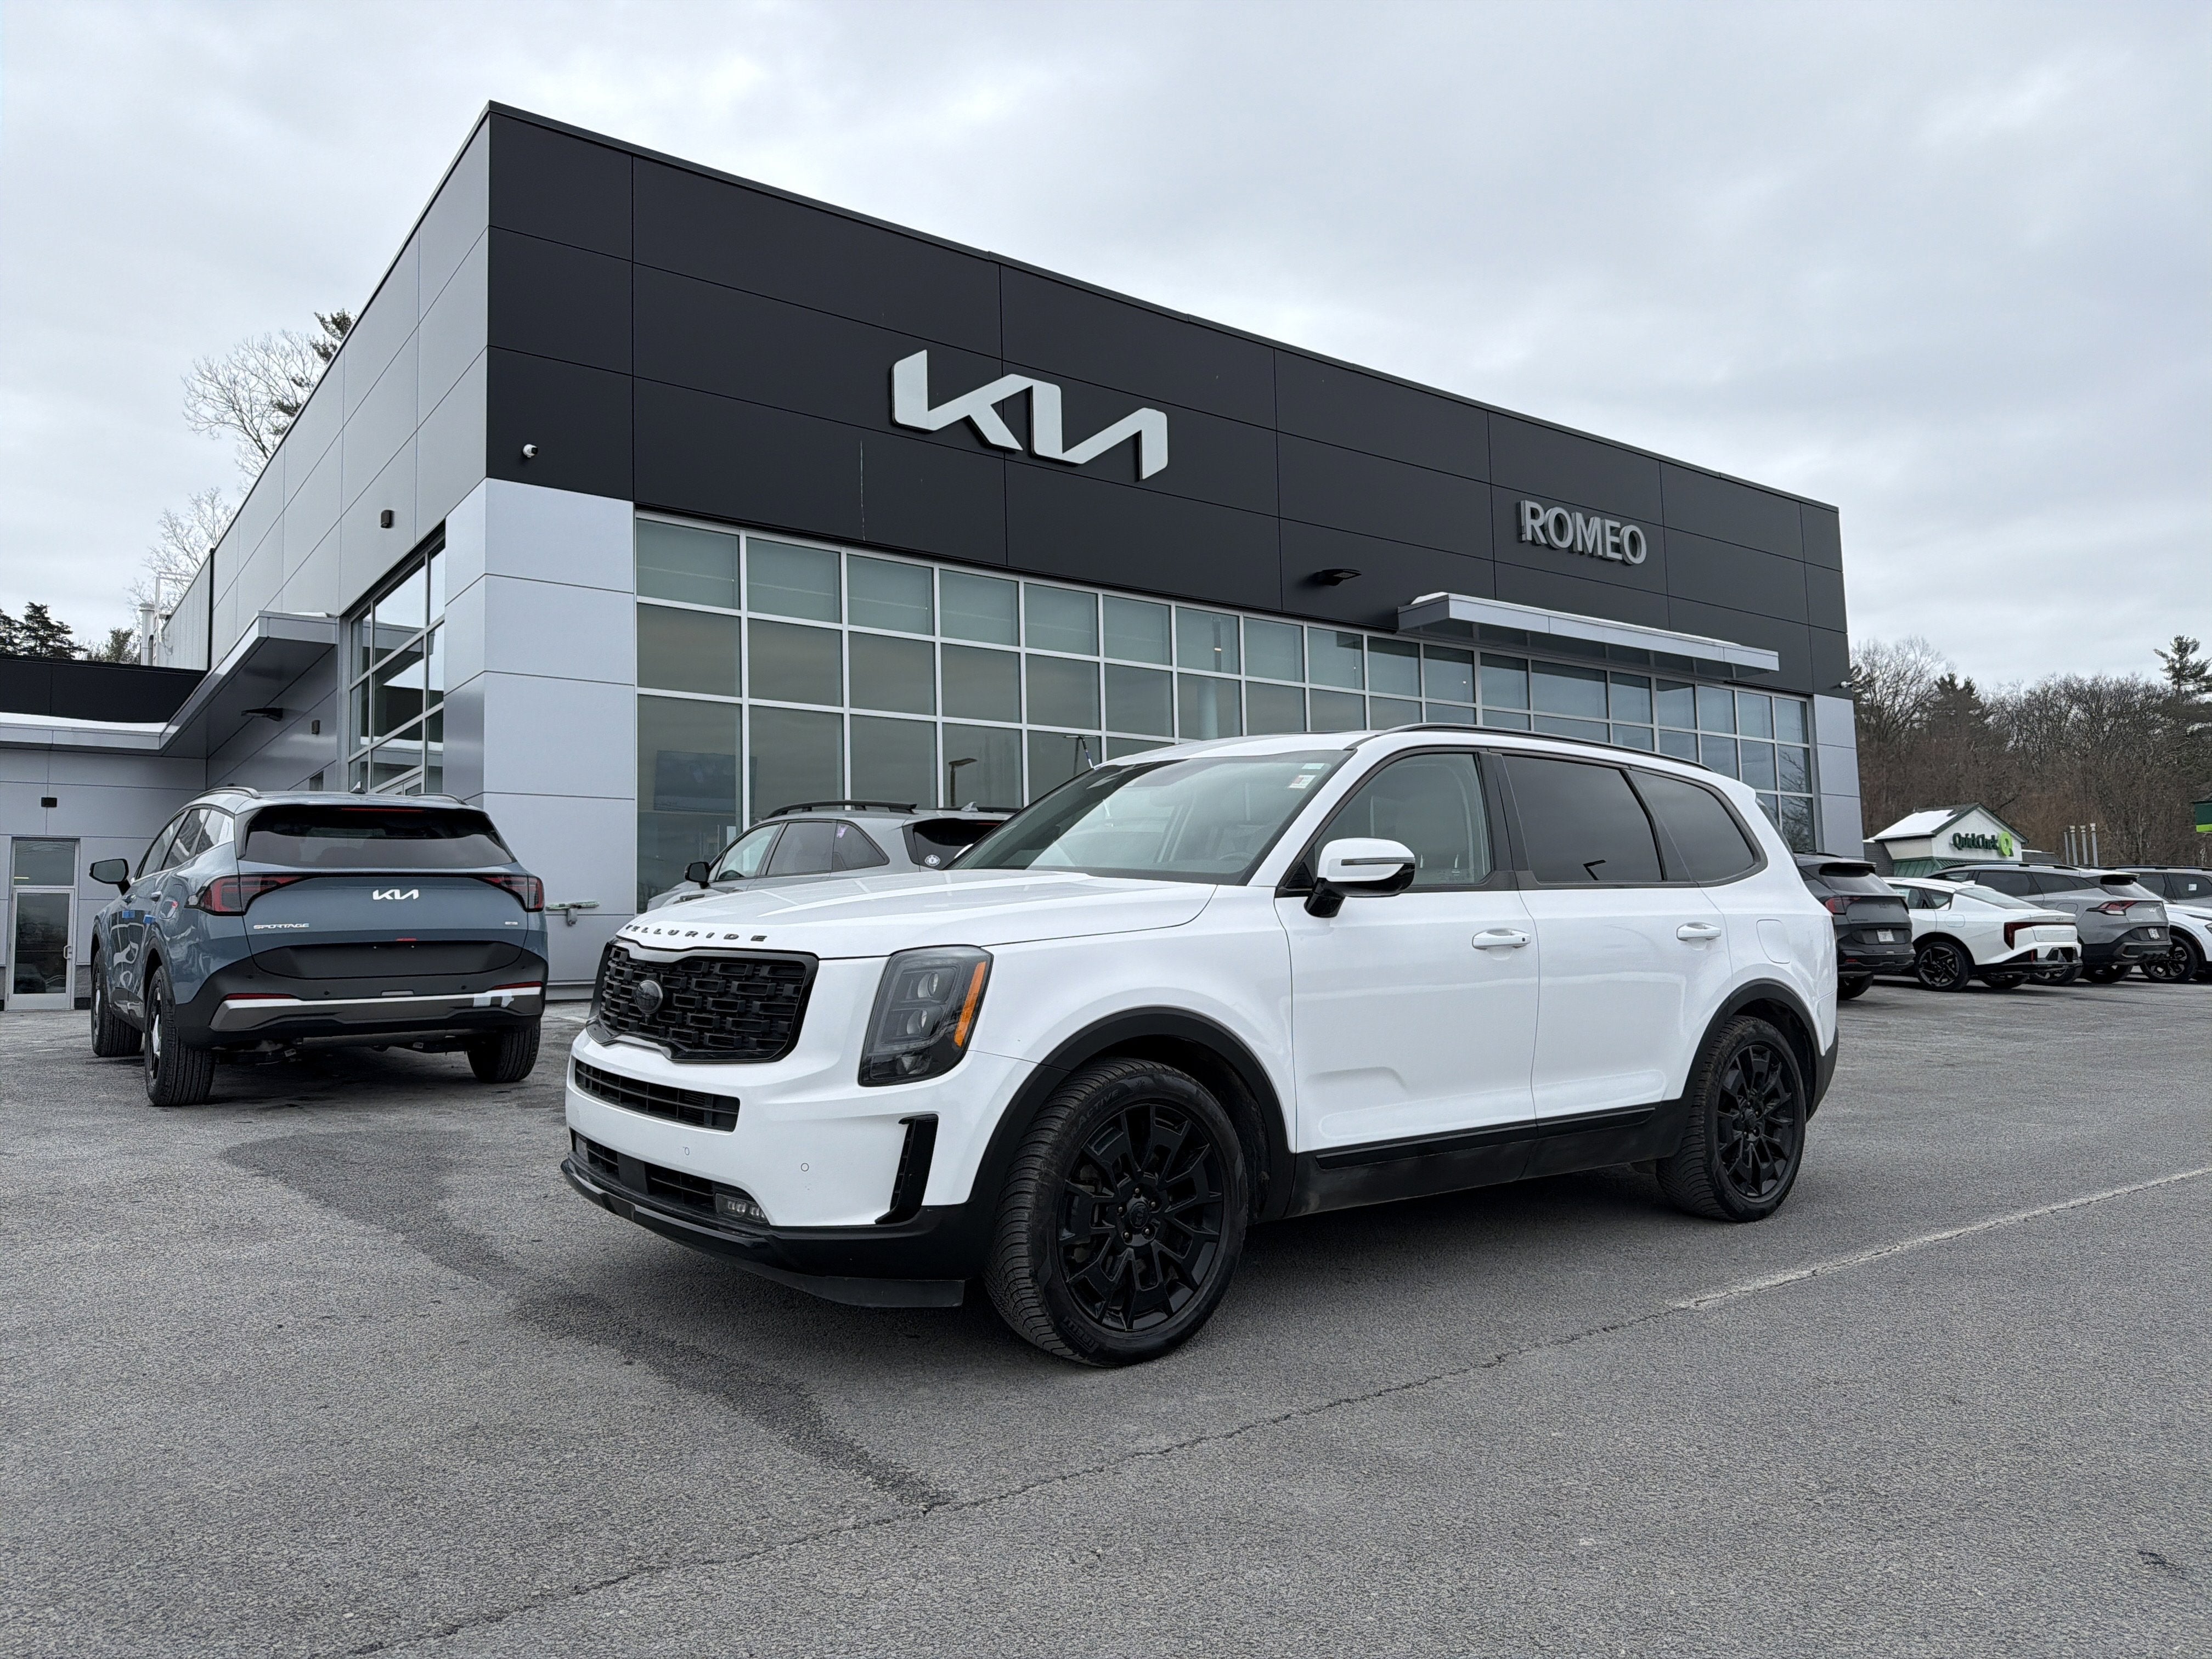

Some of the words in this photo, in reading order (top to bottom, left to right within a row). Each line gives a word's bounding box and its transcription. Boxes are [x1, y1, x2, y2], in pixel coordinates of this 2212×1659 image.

[891, 349, 1168, 480] KIA
[1520, 500, 1647, 565] ROMEO
[373, 889, 419, 900] KIA
[625, 924, 768, 942] TELLURIDE
